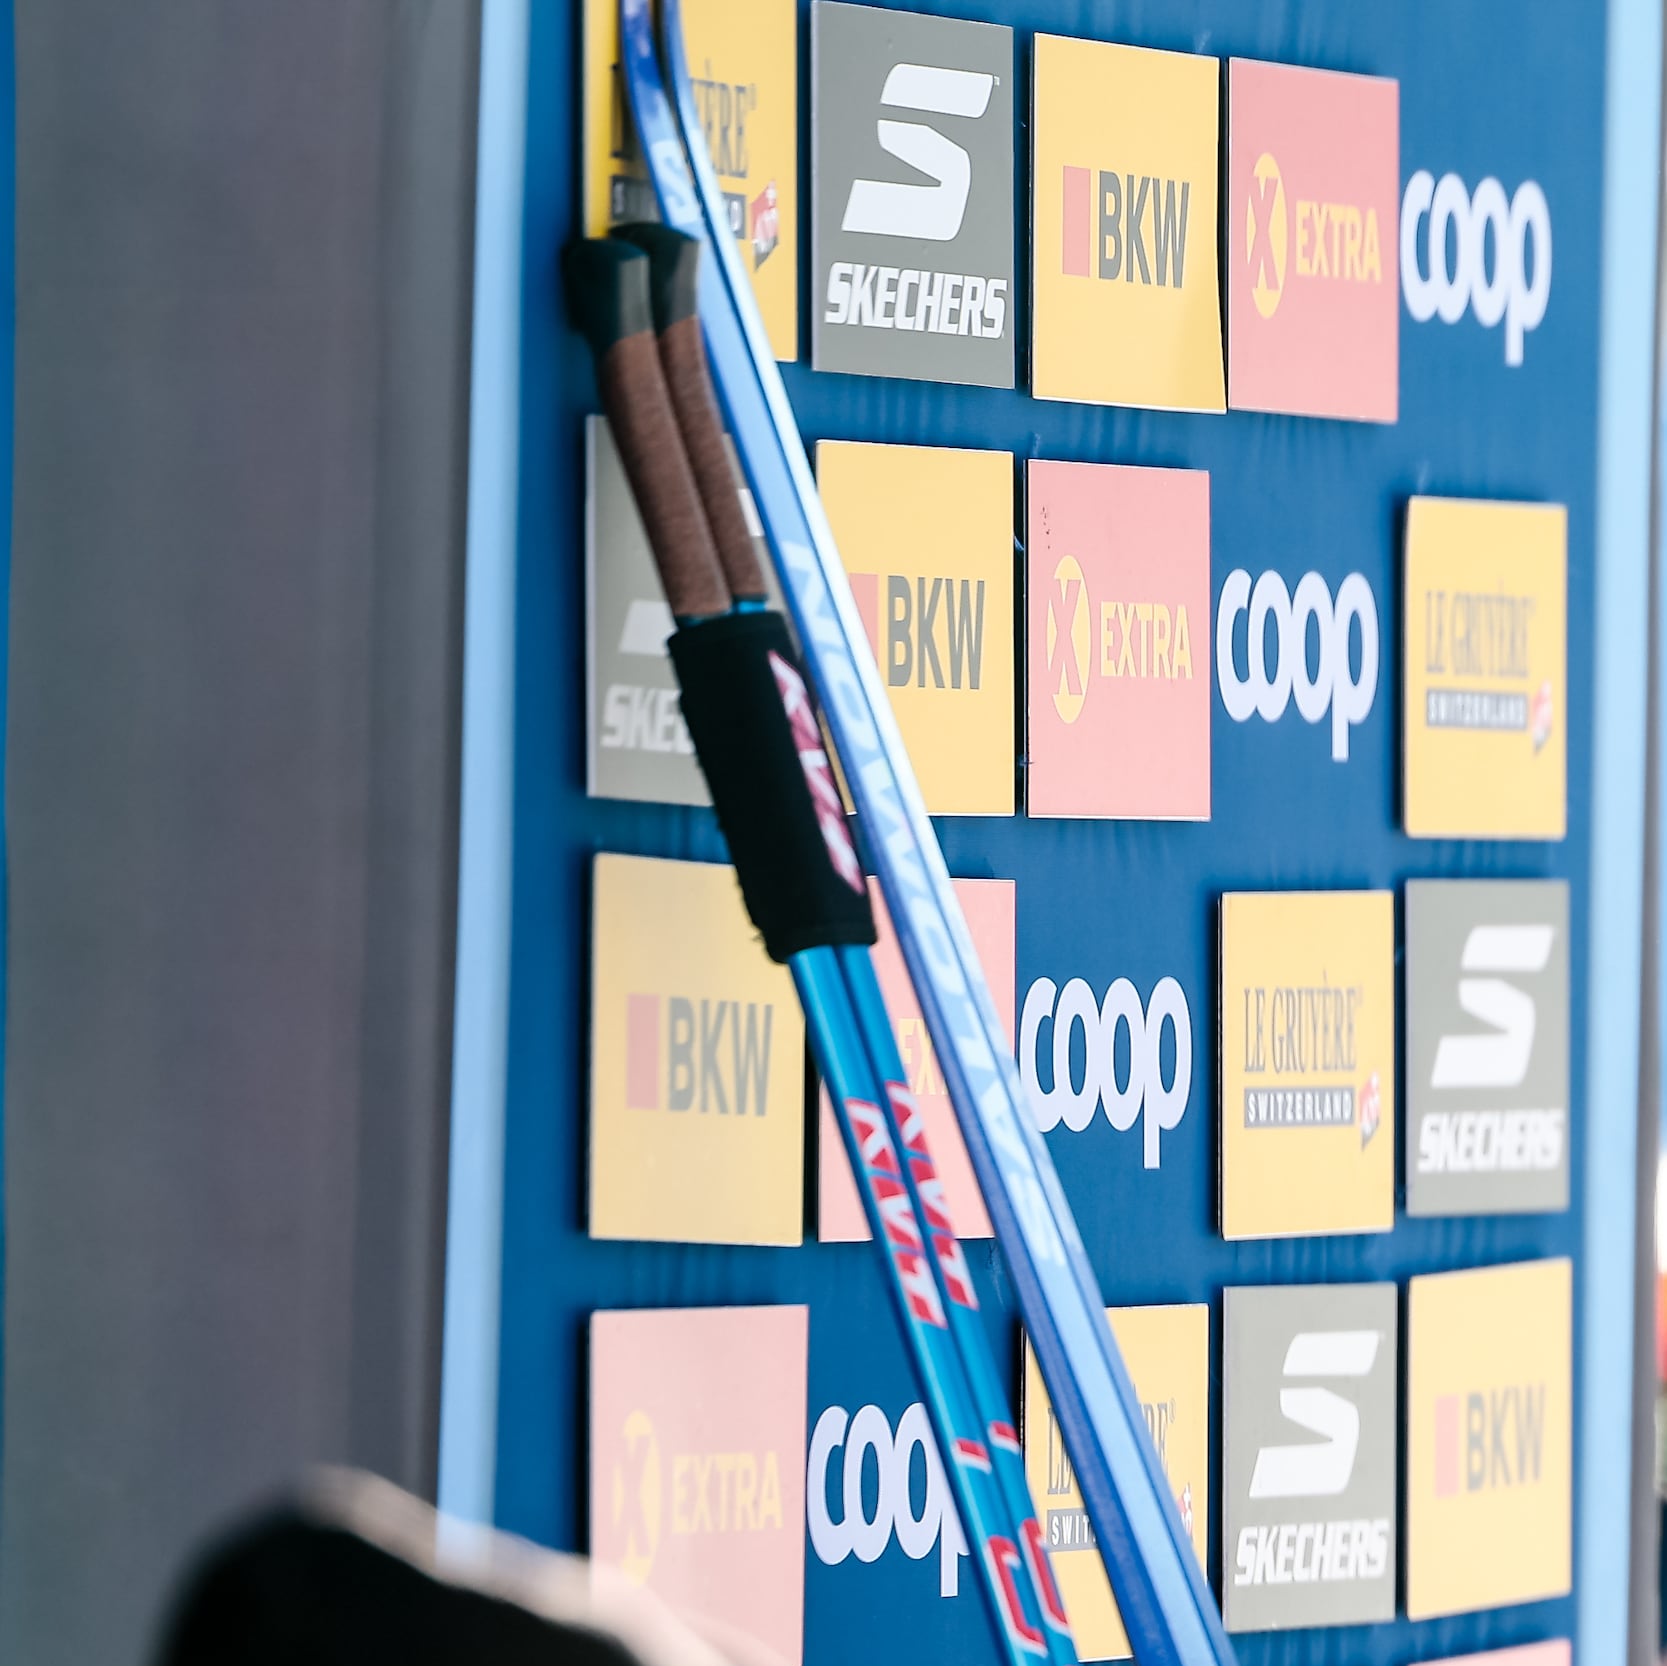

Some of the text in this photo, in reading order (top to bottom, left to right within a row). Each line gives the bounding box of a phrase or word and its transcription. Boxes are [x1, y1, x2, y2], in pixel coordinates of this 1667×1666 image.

[1098, 169, 1190, 290] BKW
[1295, 199, 1383, 283] EXTRA
[1400, 169, 1553, 367] coop
[824, 261, 1009, 340] SKECHERS
[886, 574, 985, 690] BKW
[1100, 601, 1194, 680] EXTRA
[1216, 568, 1380, 763] coop
[667, 995, 774, 1118] BKW
[1244, 987, 1266, 1072] LE
[1019, 975, 1193, 1170] coop
[1248, 1089, 1353, 1124] SWITZERLAND
[1417, 1109, 1564, 1175] SKECHERS
[1466, 1382, 1547, 1493] BKW
[672, 1450, 784, 1535] EXTRA
[1234, 1518, 1391, 1588] SKECHERS
